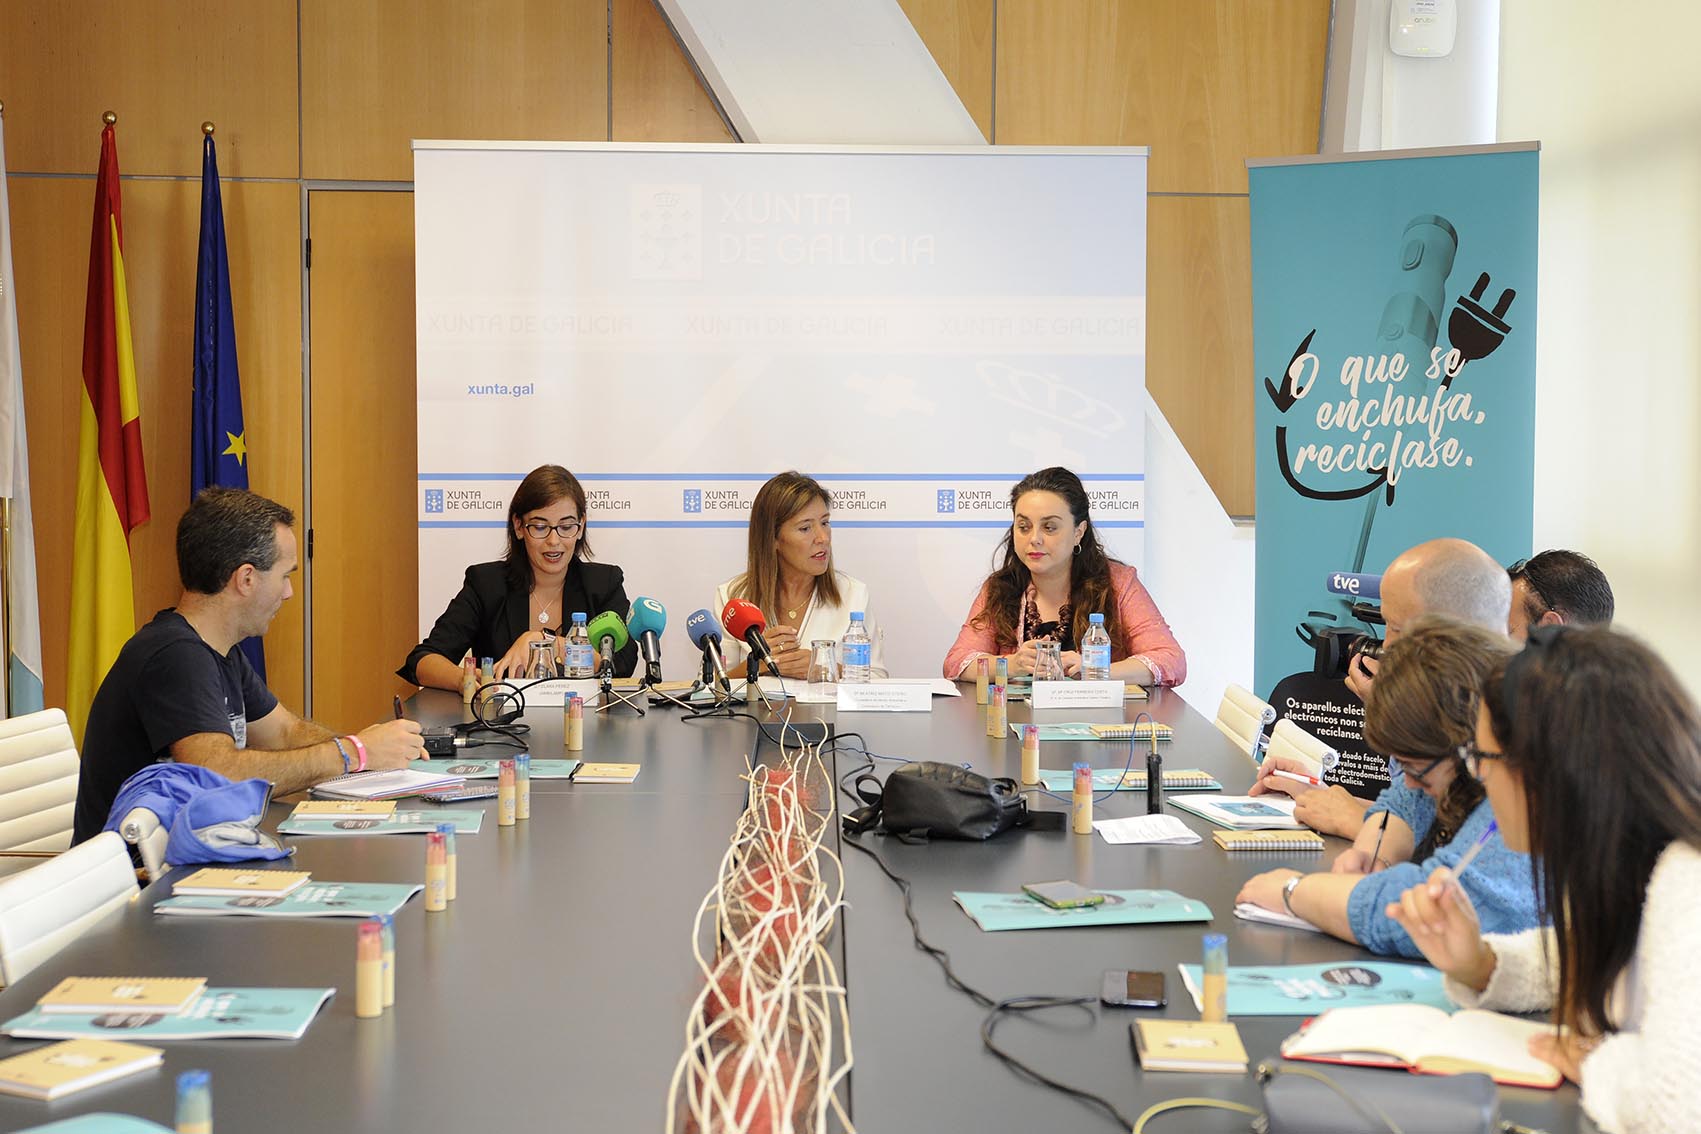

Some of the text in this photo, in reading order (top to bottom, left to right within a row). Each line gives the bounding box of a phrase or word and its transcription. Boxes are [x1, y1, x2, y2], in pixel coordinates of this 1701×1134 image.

[720, 192, 852, 224] XUNTA
[719, 234, 936, 265] DE GALICIA
[1288, 346, 1466, 400] O que se
[468, 383, 534, 398] xunta.gal
[1316, 384, 1487, 441] enchufa,
[447, 490, 481, 500] XUNTA
[584, 490, 610, 500] UNTA
[705, 490, 739, 500] XUNTA
[833, 491, 866, 500] XUNTA
[958, 491, 992, 500] XUNTA
[446, 500, 503, 510] DE GALICIA
[591, 500, 631, 510] GALICIA
[705, 500, 753, 510] DE GALICI
[833, 500, 887, 510] DE GALICIA
[958, 500, 1012, 510] DE GALICIA
[1099, 500, 1139, 510] GALICIA
[1333, 574, 1360, 594] tve
[687, 614, 706, 627] tve
[1286, 697, 1366, 716] Os aparellos eléct
[1284, 709, 1338, 725] electrónicos
[1340, 718, 1358, 727] non
[1316, 726, 1363, 740] recíclanse.
[1341, 750, 1362, 761] doado
[1380, 764, 1389, 772] de
[1324, 774, 1339, 782] toda
[1337, 767, 1392, 782] electrodoméstic
